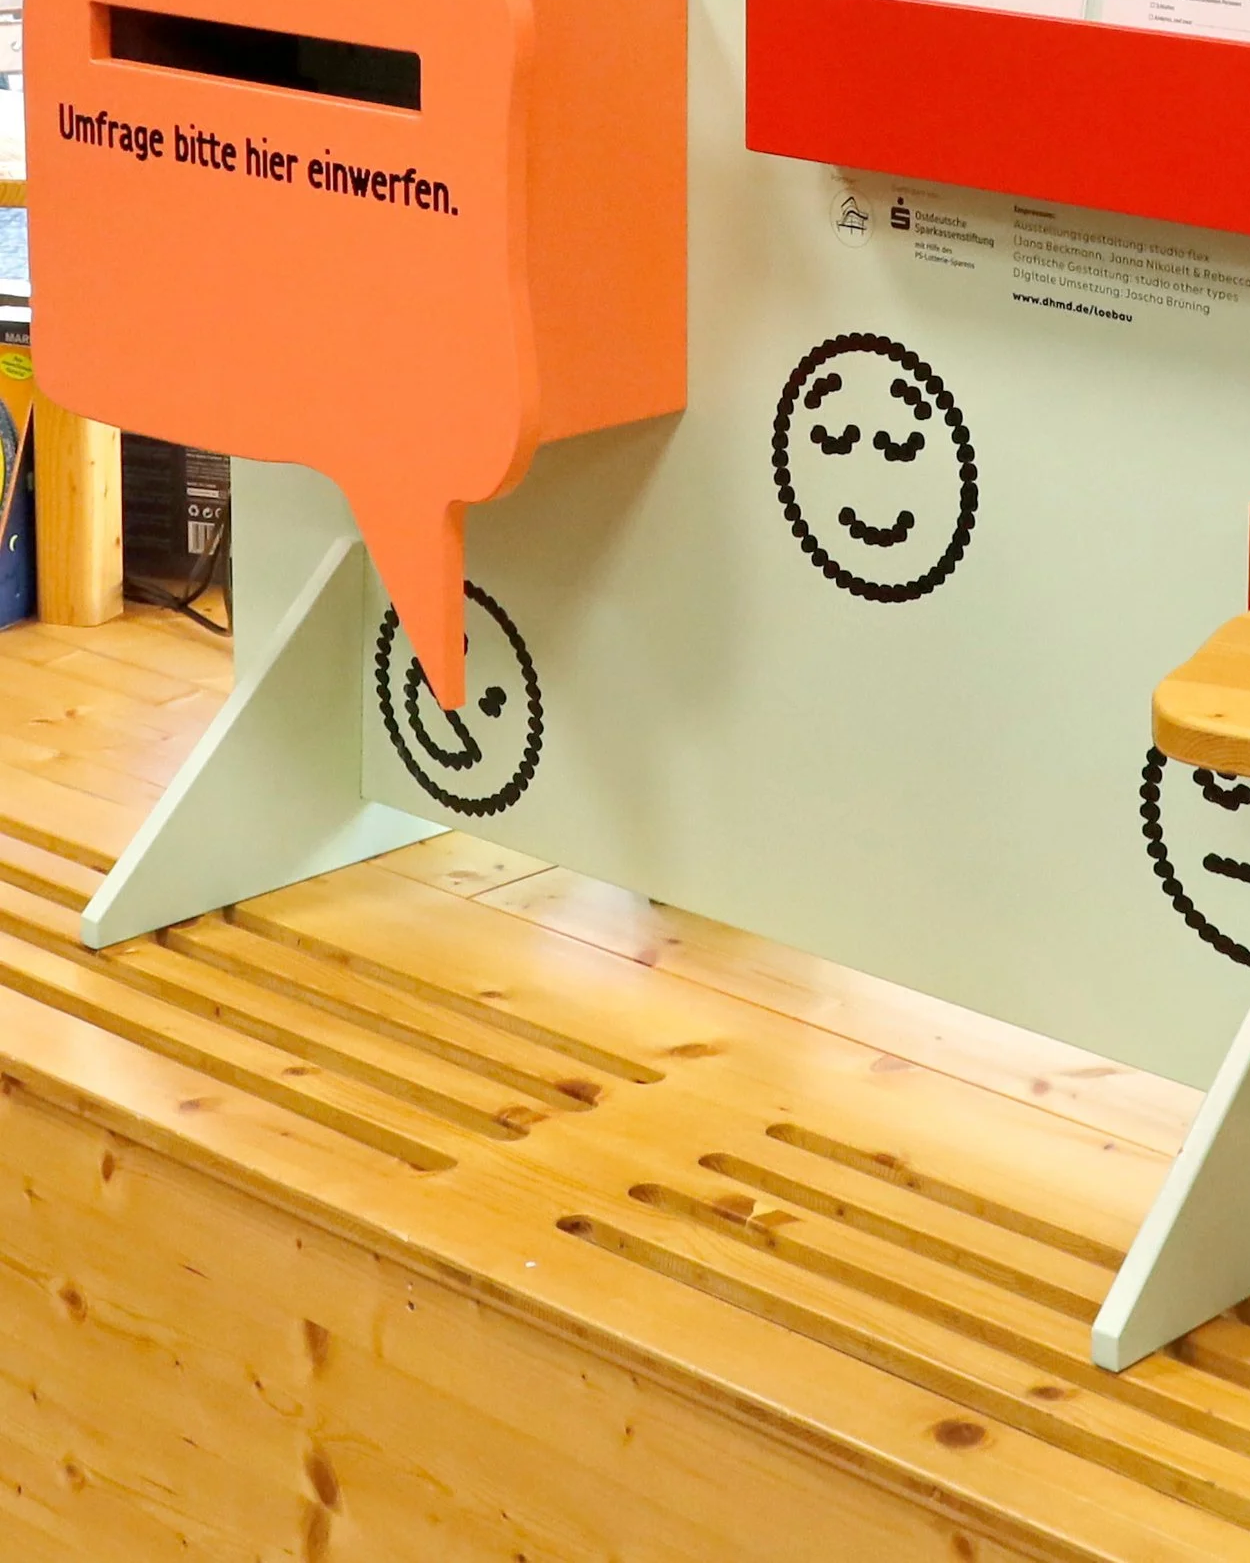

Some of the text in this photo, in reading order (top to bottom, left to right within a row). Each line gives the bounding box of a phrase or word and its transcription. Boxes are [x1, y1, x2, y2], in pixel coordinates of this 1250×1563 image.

[59, 103, 458, 216] Umfrage bitte hier einwerfen.
[914, 210, 968, 228] Ostdeutsche
[914, 223, 995, 248] Sparkassenstiftung
[1013, 234, 1044, 250] (Jana
[1110, 252, 1144, 268] Janna
[1149, 244, 1185, 258] studio
[1013, 267, 1057, 285] Digitale
[1013, 252, 1065, 270] Grafische
[1135, 275, 1170, 289] studio
[1173, 281, 1203, 295] other
[1206, 288, 1239, 303] types
[1012, 292, 1133, 322] www.dhmd.de/loebau
